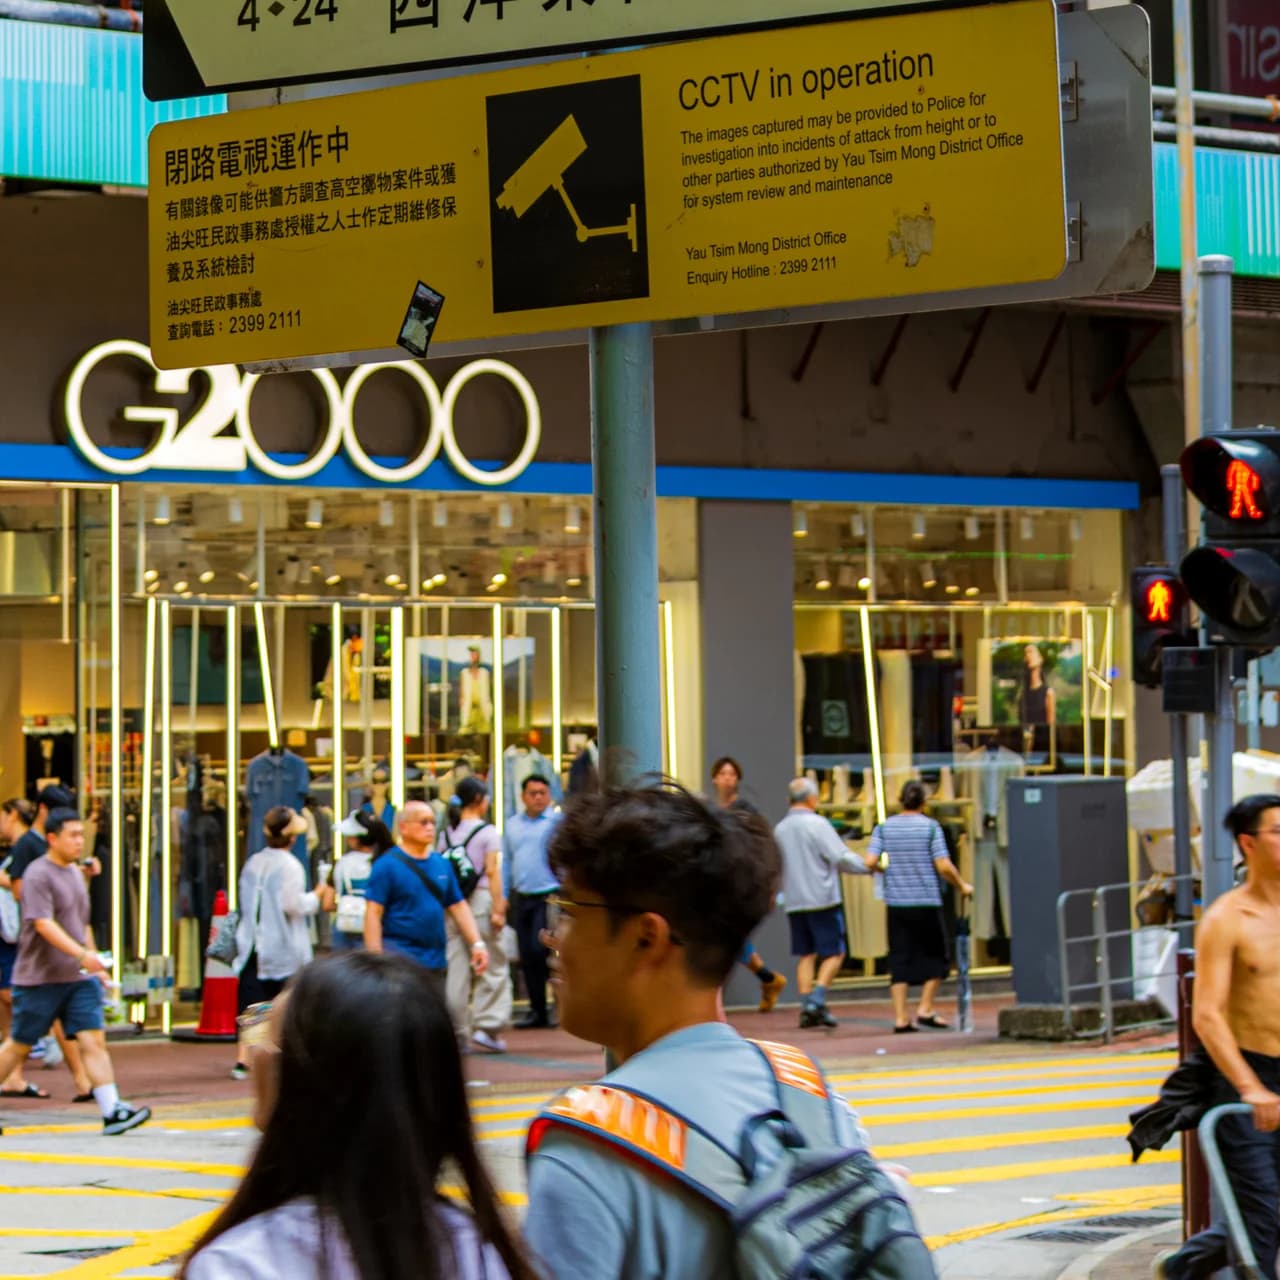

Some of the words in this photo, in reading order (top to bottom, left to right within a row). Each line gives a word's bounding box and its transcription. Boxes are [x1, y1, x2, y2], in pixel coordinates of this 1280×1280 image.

[678, 70, 760, 111] CCTV
[770, 66, 792, 99] in
[802, 49, 934, 100] operation
[680, 129, 703, 146] The
[706, 125, 749, 144] images
[752, 117, 804, 138] captured
[807, 115, 833, 131] may
[836, 108, 852, 124] be
[855, 103, 908, 125] provided
[911, 100, 924, 114] to
[926, 95, 965, 112] Police
[969, 91, 987, 107] for
[681, 143, 754, 166] investigation
[757, 141, 780, 158] into
[782, 134, 836, 153] incidents
[838, 131, 851, 147] of
[854, 125, 891, 144] attack
[894, 122, 922, 139] from
[926, 116, 965, 136] height
[967, 116, 980, 131] or
[984, 113, 997, 128] to
[164, 125, 350, 187] 閉路電視運作中
[682, 171, 712, 188] other
[715, 167, 755, 186] parties
[758, 157, 821, 177] authorized
[824, 156, 839, 172] by
[841, 151, 865, 168] Yau
[869, 147, 898, 164] Tsim
[900, 143, 936, 161] Mong
[939, 138, 983, 155] District
[985, 132, 1024, 149] Office
[682, 193, 699, 209] for
[702, 190, 744, 209] system
[746, 184, 785, 201] review
[788, 180, 811, 197] and
[814, 171, 893, 193] maintenance
[167, 252, 256, 284] 養及系統檢討
[685, 247, 707, 261] Yau
[709, 243, 735, 258] Tsim
[737, 241, 769, 256] Mong
[772, 235, 811, 251] District
[813, 231, 847, 246] Office
[687, 270, 728, 286] Enquiry
[731, 265, 770, 281] Hotline
[779, 259, 808, 276] 2399
[811, 256, 837, 271] 2111
[167, 290, 263, 317] 油尖旺民政事務處
[228, 313, 265, 336] 2399
[267, 309, 302, 331] 2111
[64, 339, 542, 486] G2000
